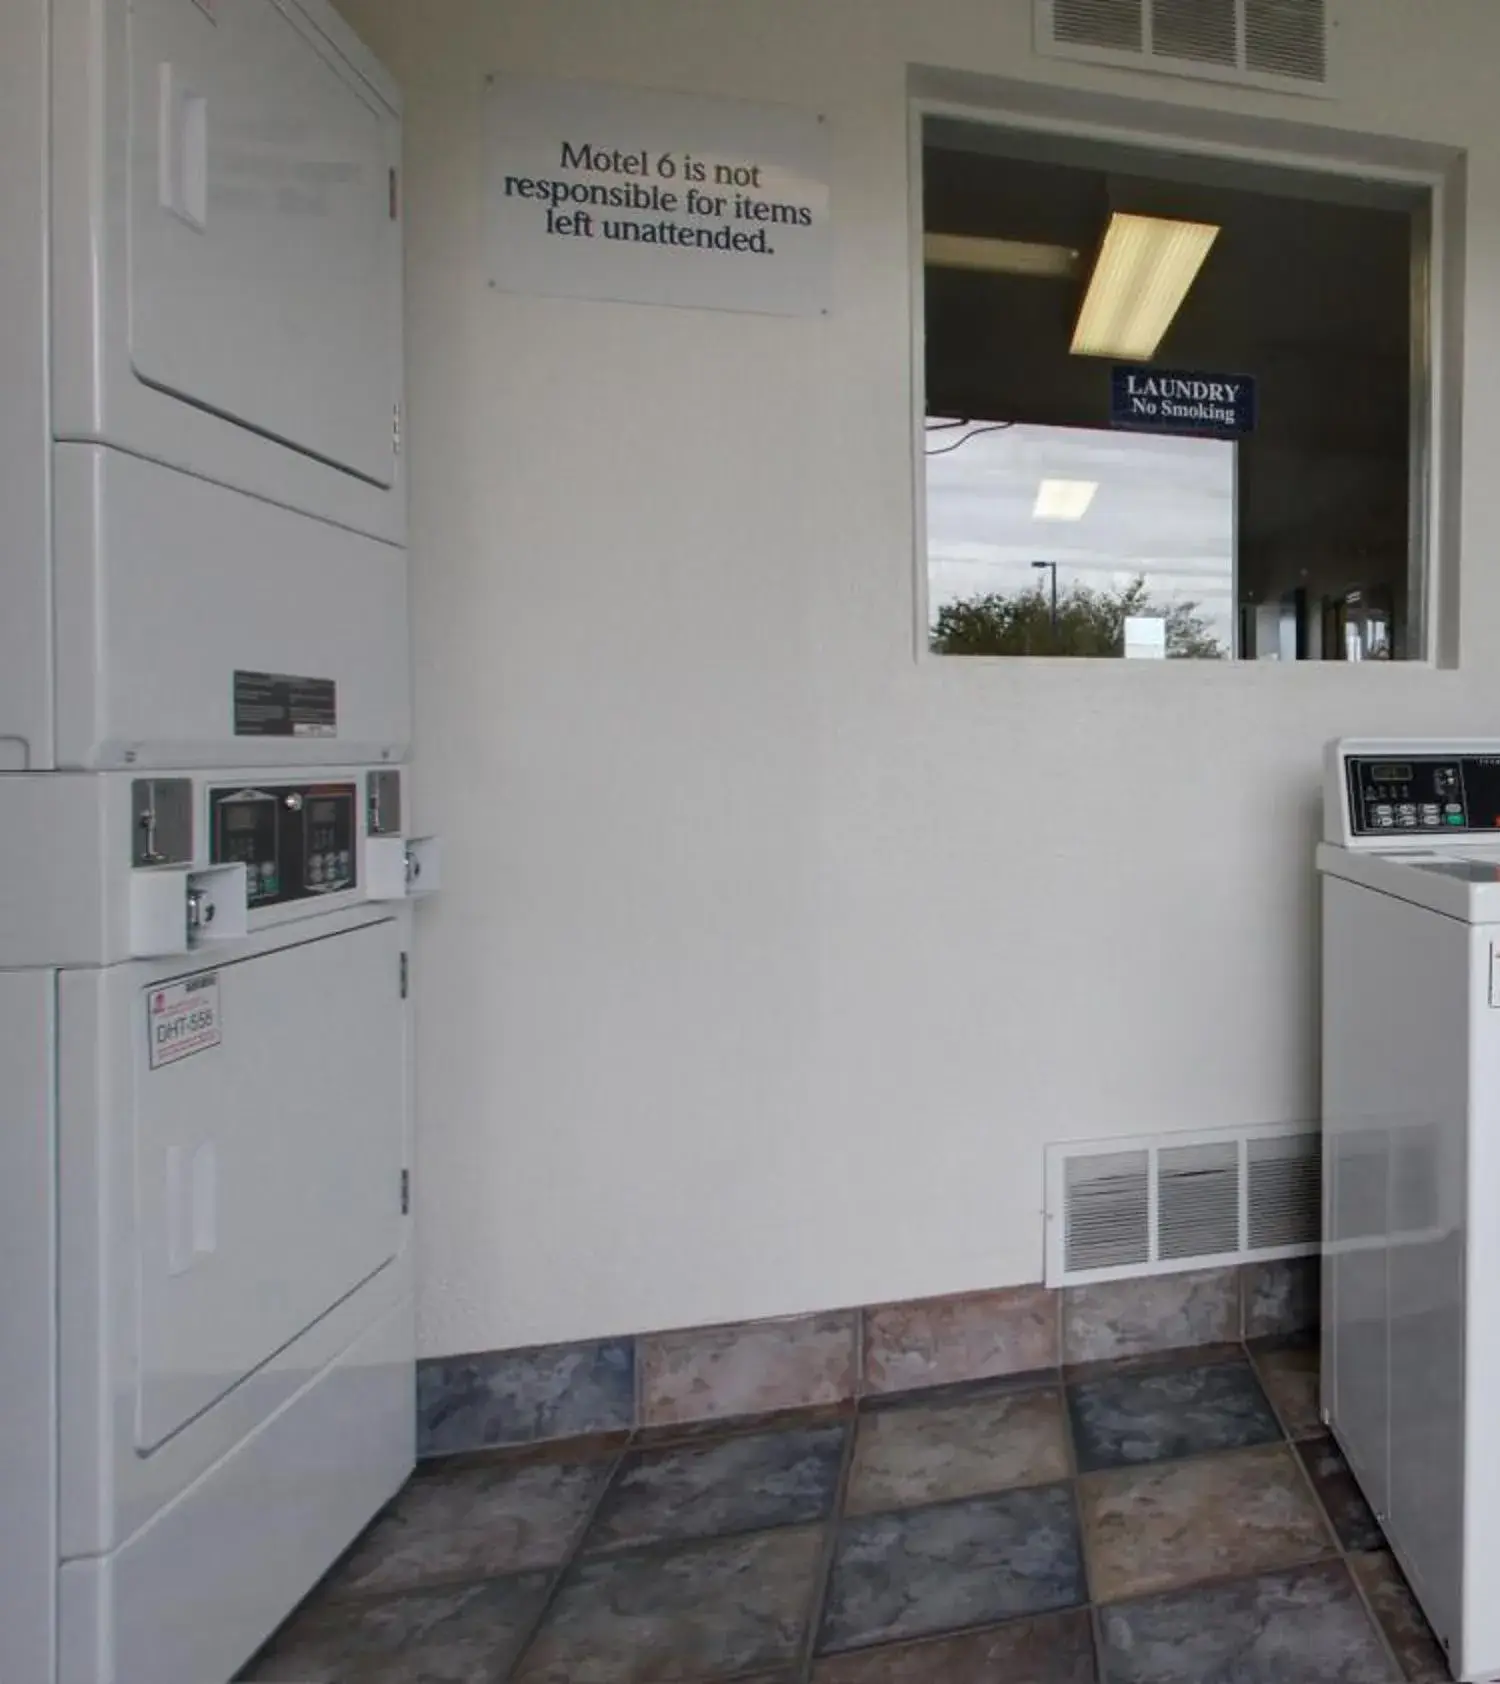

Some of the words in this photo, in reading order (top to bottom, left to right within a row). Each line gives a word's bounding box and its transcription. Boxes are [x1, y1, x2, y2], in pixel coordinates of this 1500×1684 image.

[560, 141, 649, 177] Motel
[656, 152, 677, 180] 6
[684, 154, 706, 182] is
[714, 163, 762, 188] not
[504, 174, 678, 212] responsible
[686, 187, 724, 218] for
[734, 193, 813, 226] items
[545, 208, 594, 238] left
[603, 217, 775, 255] unattended.
[1126, 375, 1240, 403] LAUNDRY
[1132, 397, 1157, 415] No
[1161, 400, 1236, 425] Smoking
